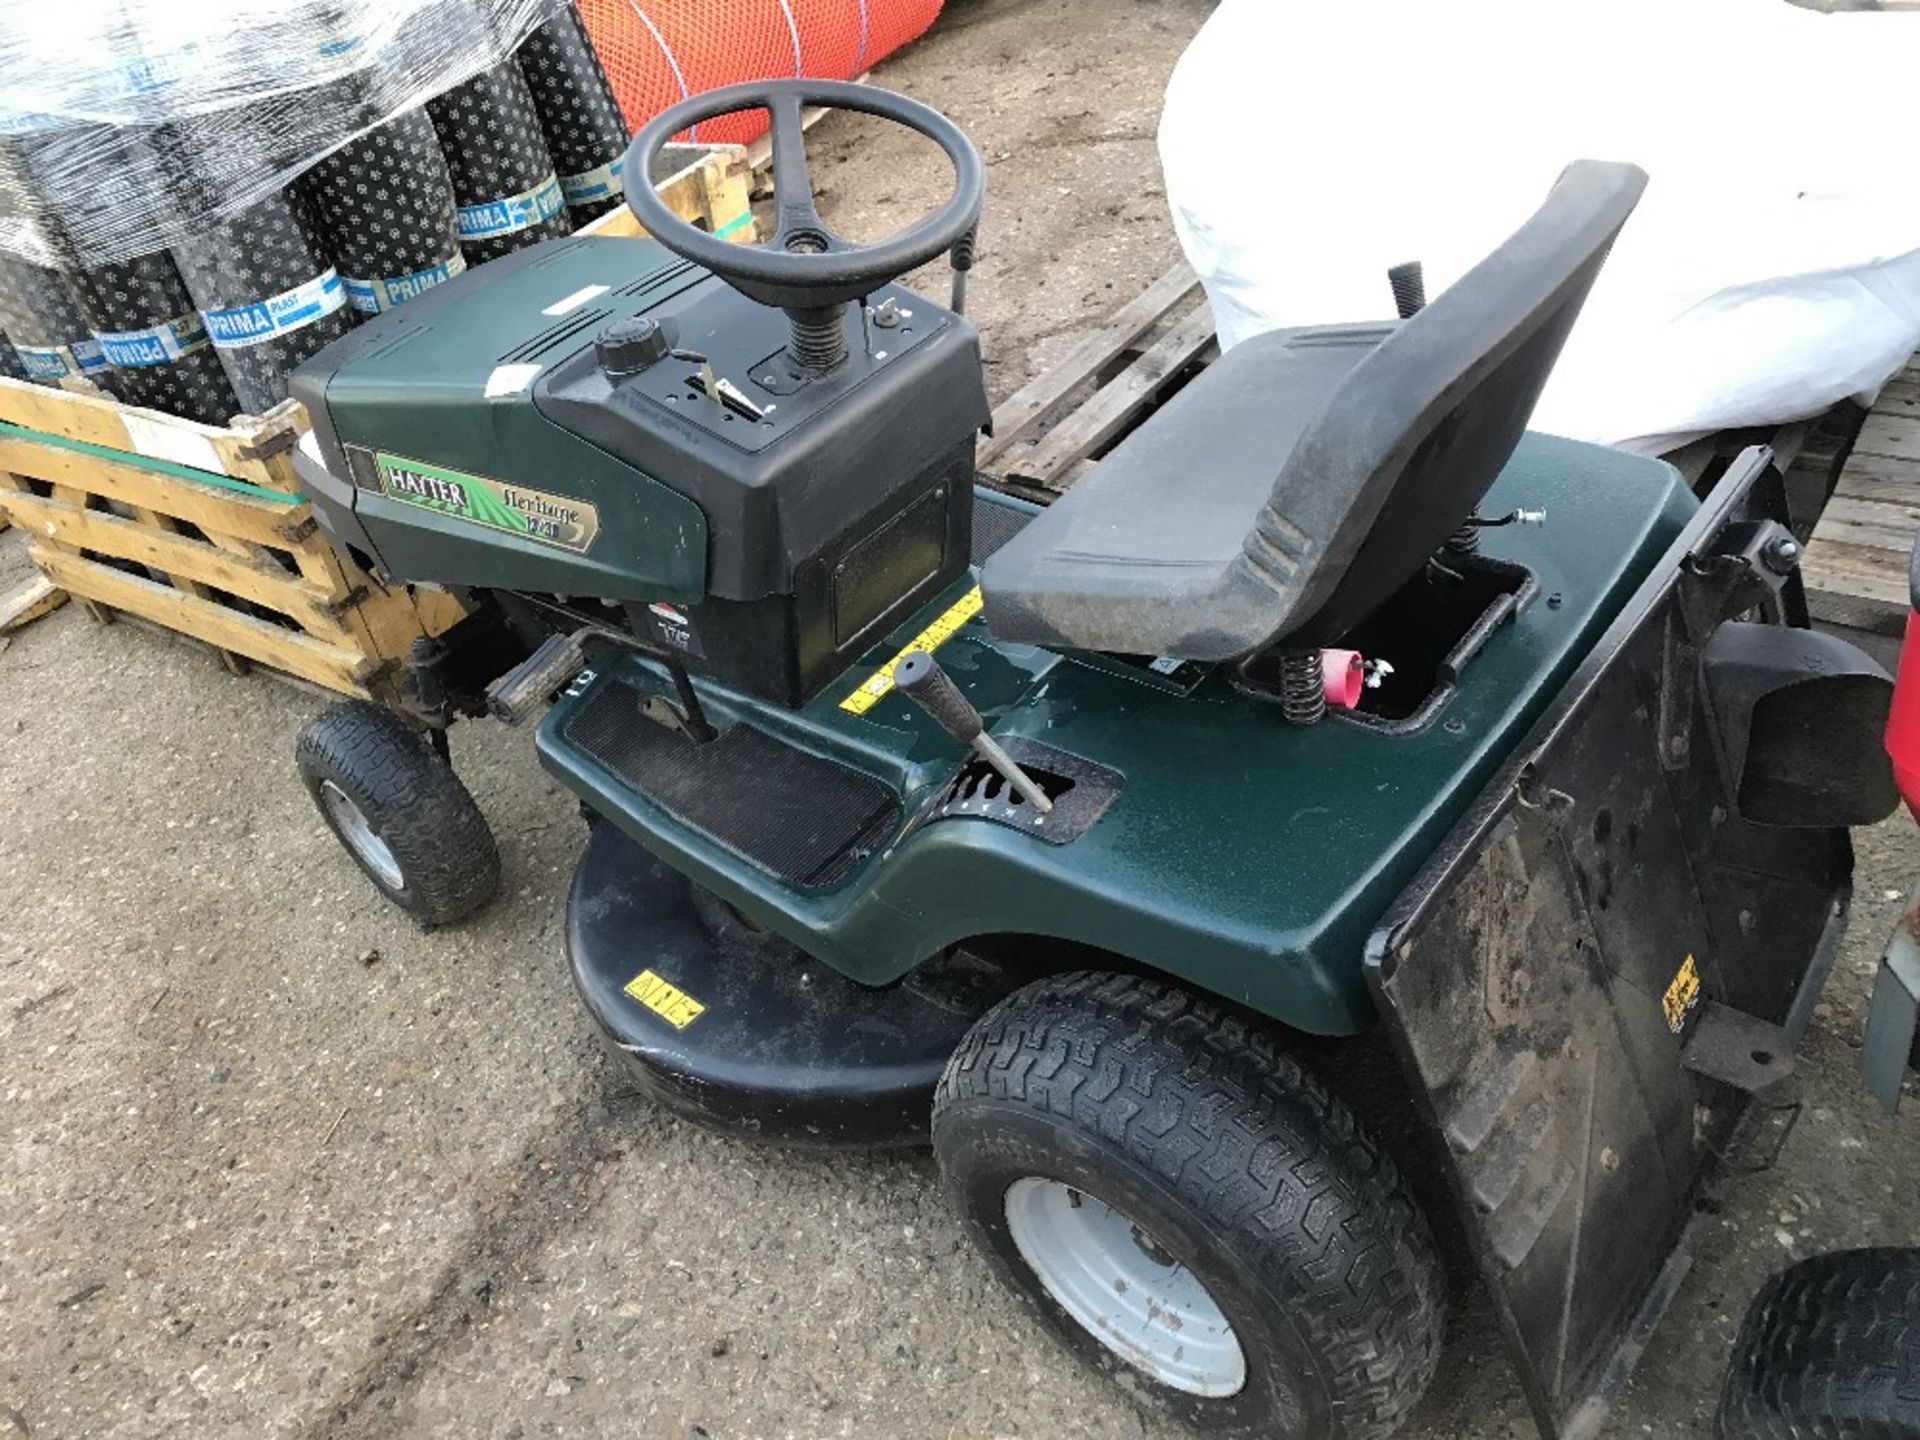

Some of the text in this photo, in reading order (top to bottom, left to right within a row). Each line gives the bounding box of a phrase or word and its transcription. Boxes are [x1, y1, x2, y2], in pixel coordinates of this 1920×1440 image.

[458, 206, 508, 232] RIMA
[387, 269, 447, 303] PRIMA
[208, 308, 272, 336] PRIMA
[387, 466, 467, 507] HAYTER
[504, 488, 580, 524] Heritage
